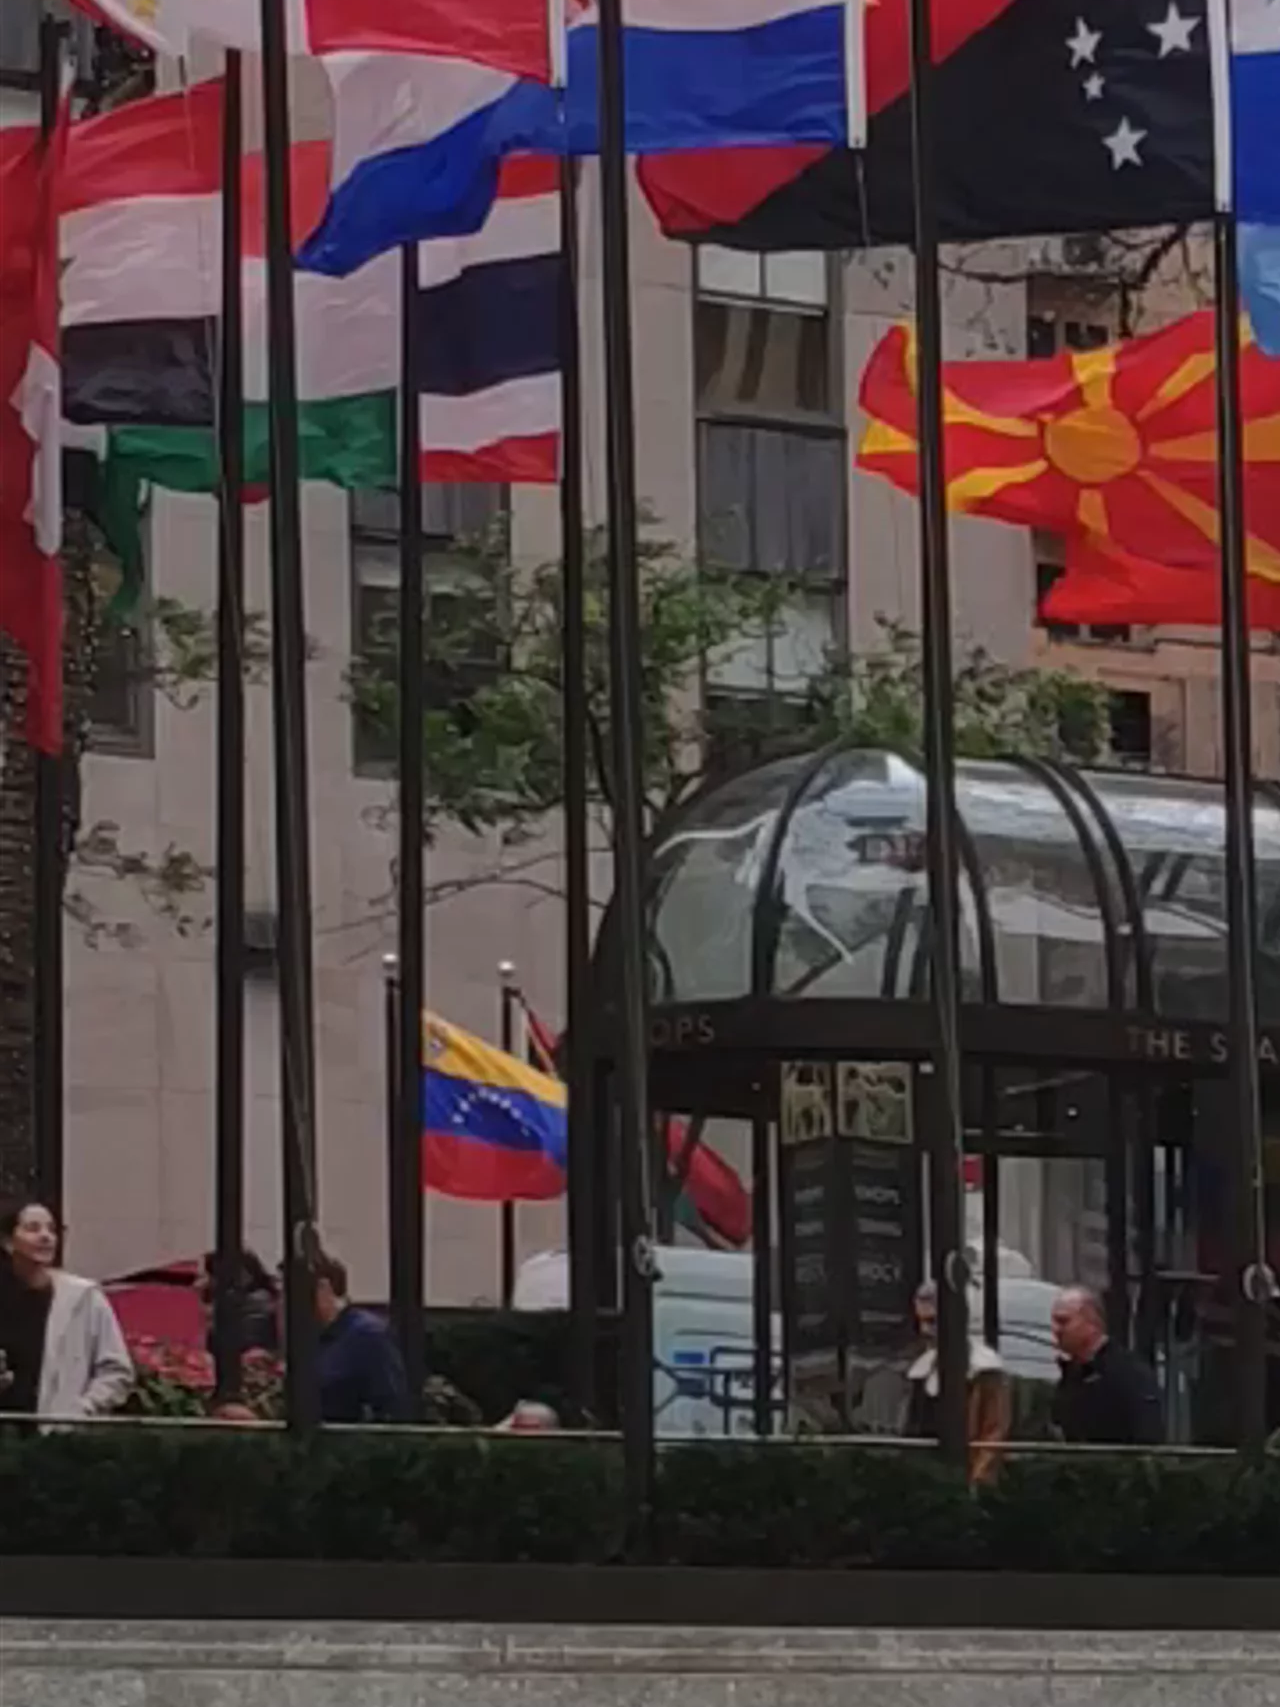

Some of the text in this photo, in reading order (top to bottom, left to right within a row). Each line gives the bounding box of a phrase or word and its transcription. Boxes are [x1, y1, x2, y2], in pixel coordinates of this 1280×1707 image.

[650, 1013, 717, 1047] OPS
[1124, 1024, 1193, 1061] THE
[1208, 1030, 1279, 1066] SA
